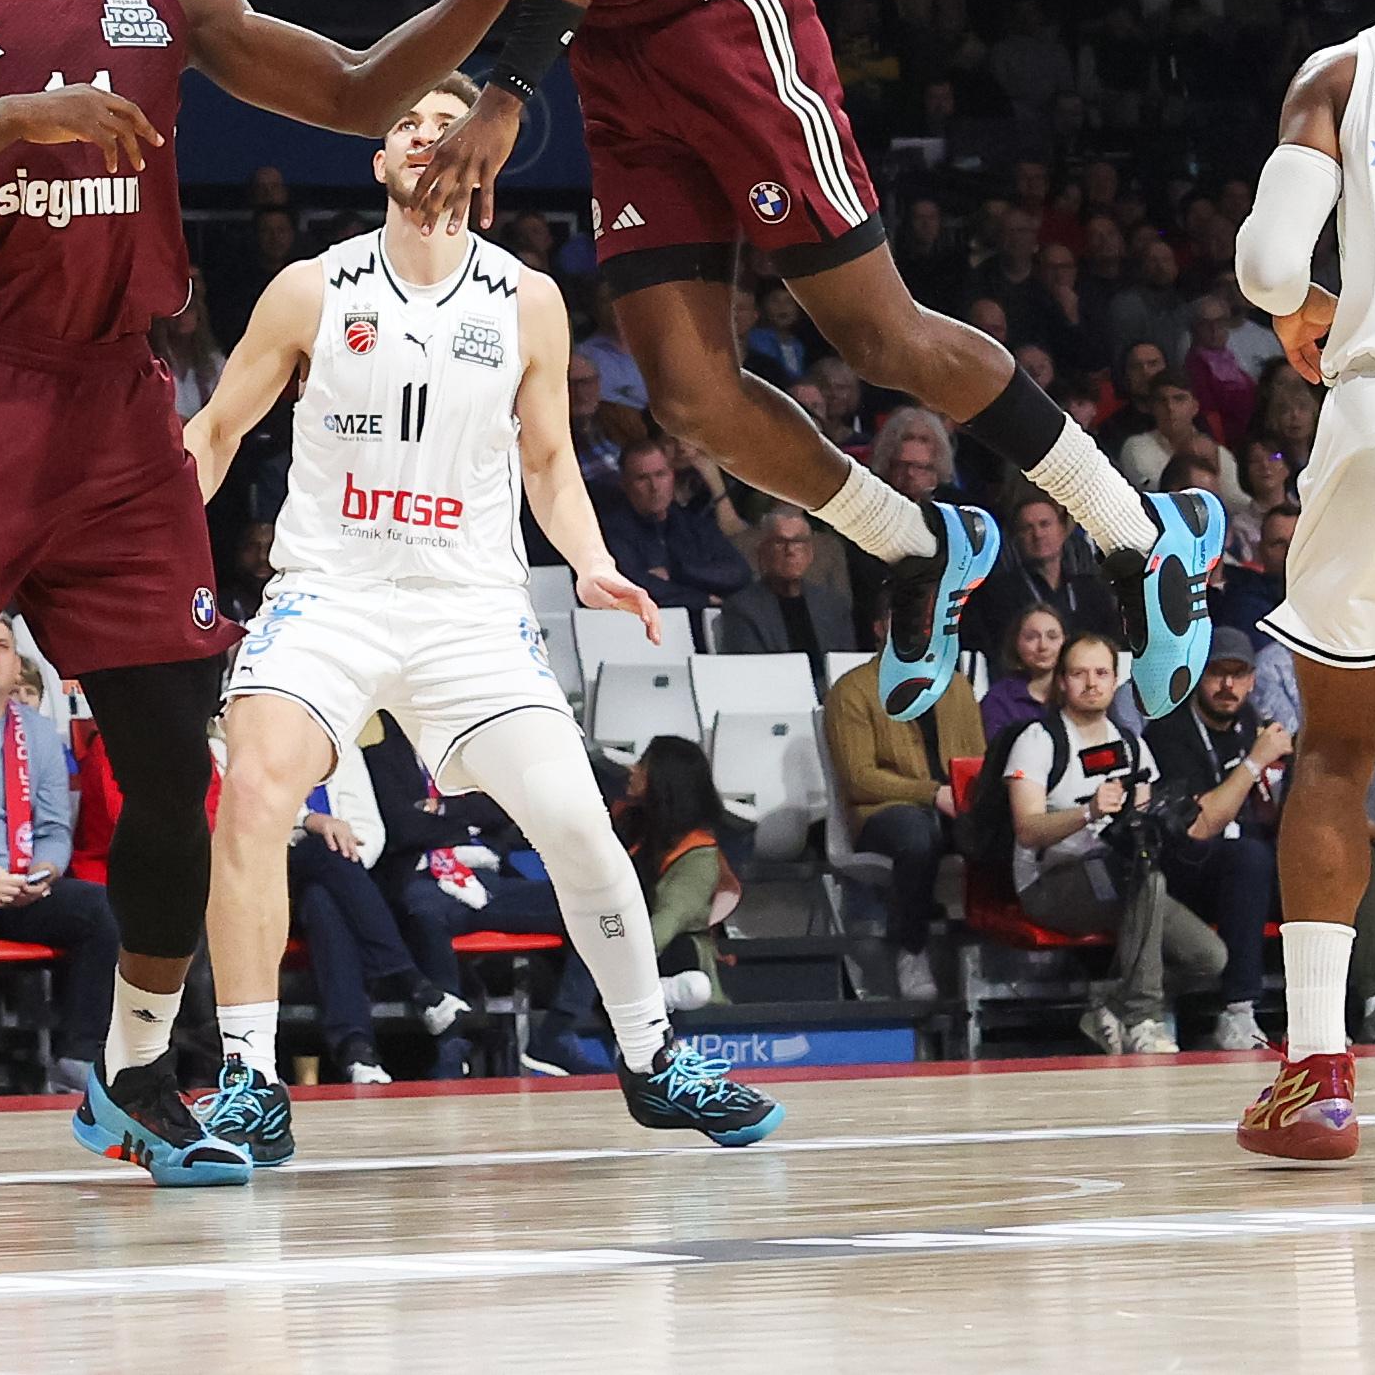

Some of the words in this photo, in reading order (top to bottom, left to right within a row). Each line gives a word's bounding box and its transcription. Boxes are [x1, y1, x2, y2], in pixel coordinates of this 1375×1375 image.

[108, 8, 154, 23] TOP
[106, 22, 165, 37] FOUR
[460, 322, 501, 344] TOP
[452, 336, 505, 364] FOUR
[399, 382, 429, 443] 11
[333, 414, 383, 435] MZE
[342, 471, 464, 530] brose
